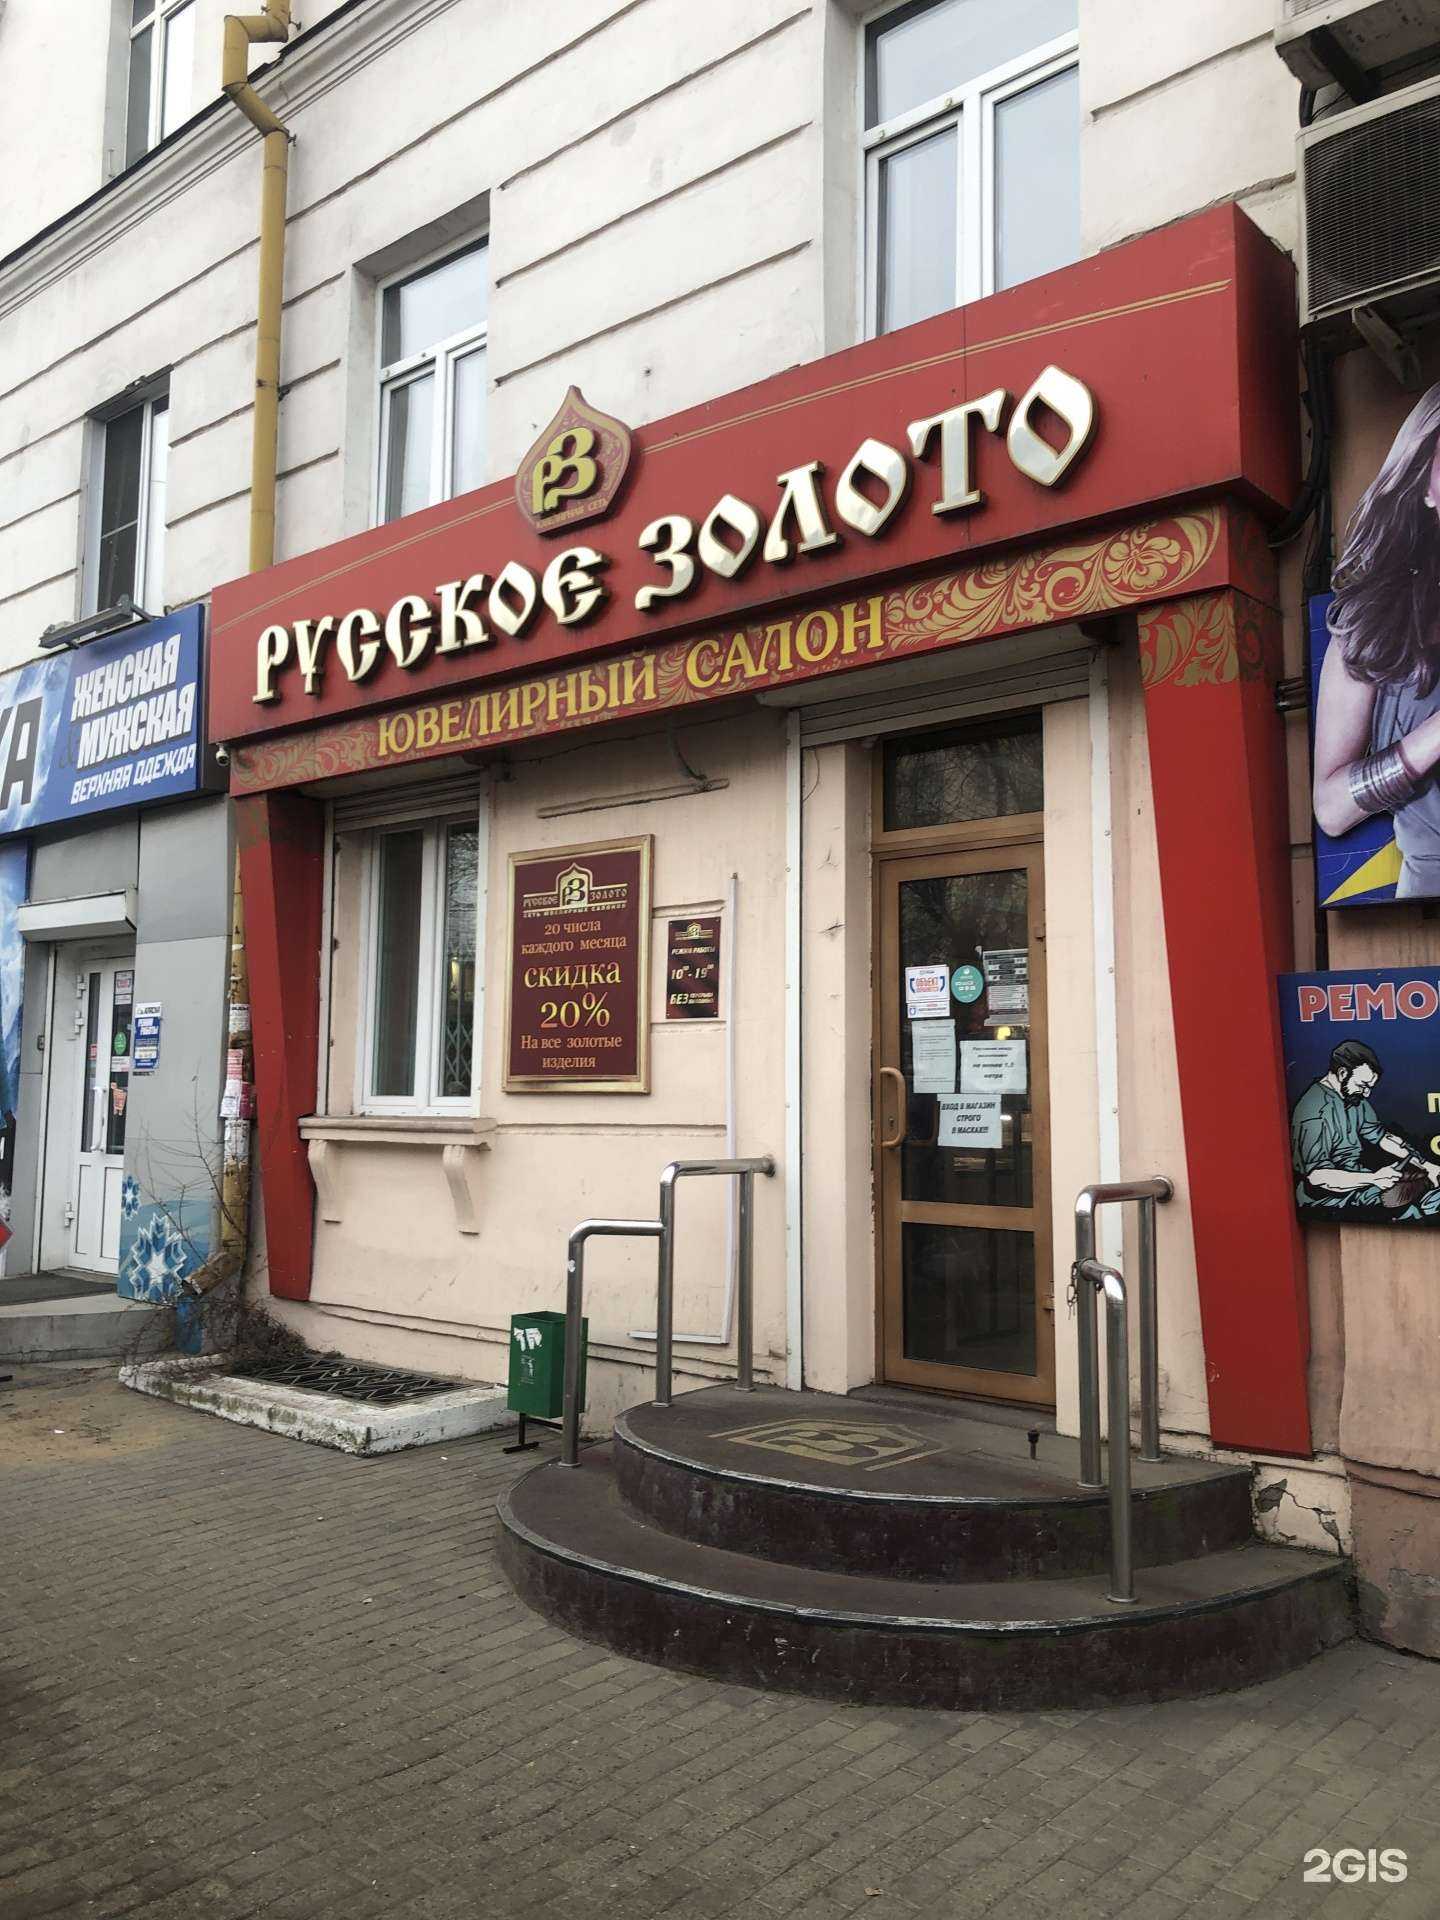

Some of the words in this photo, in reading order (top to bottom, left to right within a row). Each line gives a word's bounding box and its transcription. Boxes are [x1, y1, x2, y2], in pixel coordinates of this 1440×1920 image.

[253, 546, 604, 704] РУССКОЕ
[635, 364, 1094, 611] ЗОЛОТО
[71, 633, 182, 722] ЖЕНСКАЯ
[378, 648, 657, 756] ЮВЕЛИРНЫЙ
[686, 596, 889, 689] САЛОН
[77, 682, 197, 769] МУЖСКАЯ
[71, 763, 131, 804] ВЕРХНЯЯ
[133, 743, 197, 786] ОДЕЖДА
[590, 888, 628, 902] ЗОЛОТО
[544, 923, 560, 935] 20
[563, 920, 602, 934] числа
[521, 941, 575, 955] каждого
[579, 936, 628, 951] месяца
[540, 992, 610, 1029] 20%
[1298, 980, 1440, 1022] РЕМО
[521, 1036, 540, 1049] На
[541, 1037, 562, 1049] все
[566, 1035, 623, 1049] золотые
[542, 1057, 596, 1070] изделия
[956, 1114, 982, 1122] СТРОГО
[966, 1101, 996, 1110] МАГАЗИН
